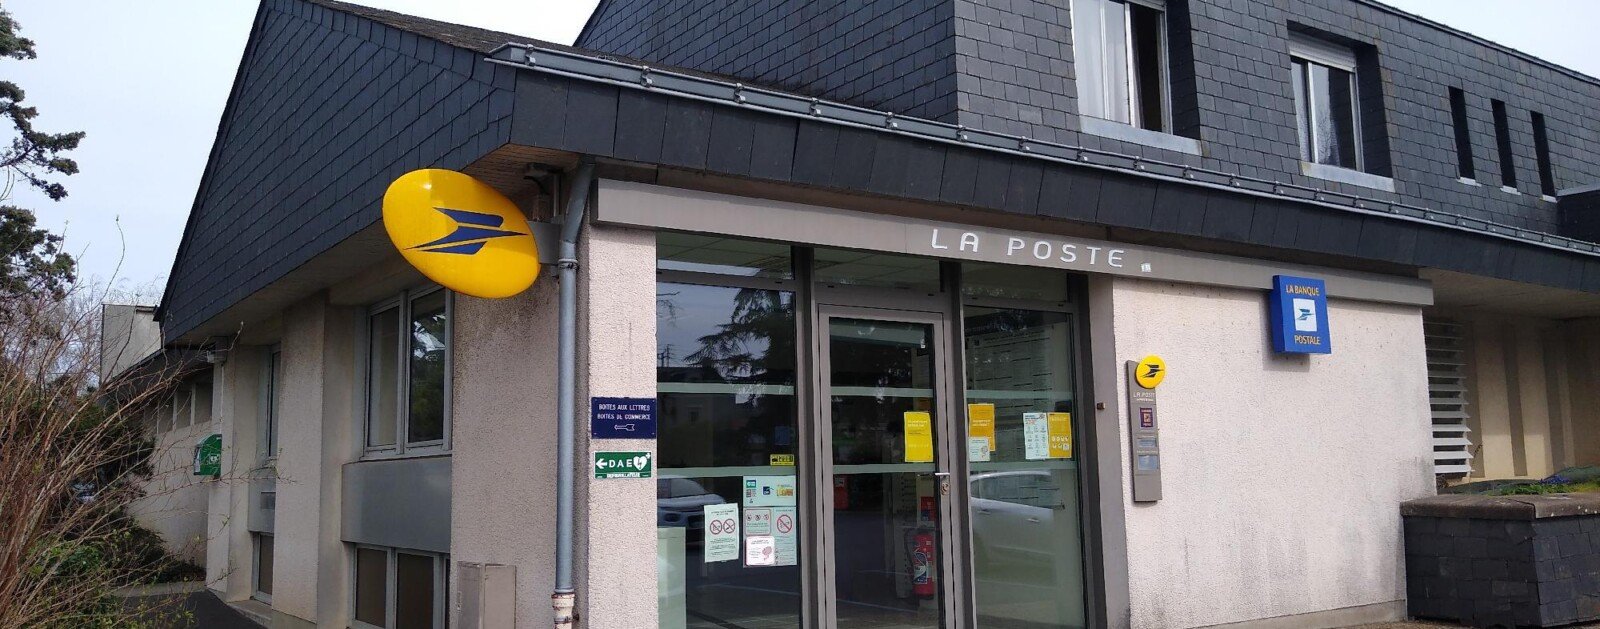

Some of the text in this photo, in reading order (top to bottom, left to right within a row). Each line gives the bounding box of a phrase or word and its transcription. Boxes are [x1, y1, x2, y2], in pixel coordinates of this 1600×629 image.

[931, 229, 1125, 268] LA POSTE
[1285, 284, 1320, 297] LA BANQUE
[1294, 335, 1321, 345] POSTALE
[608, 459, 633, 468] DAE
